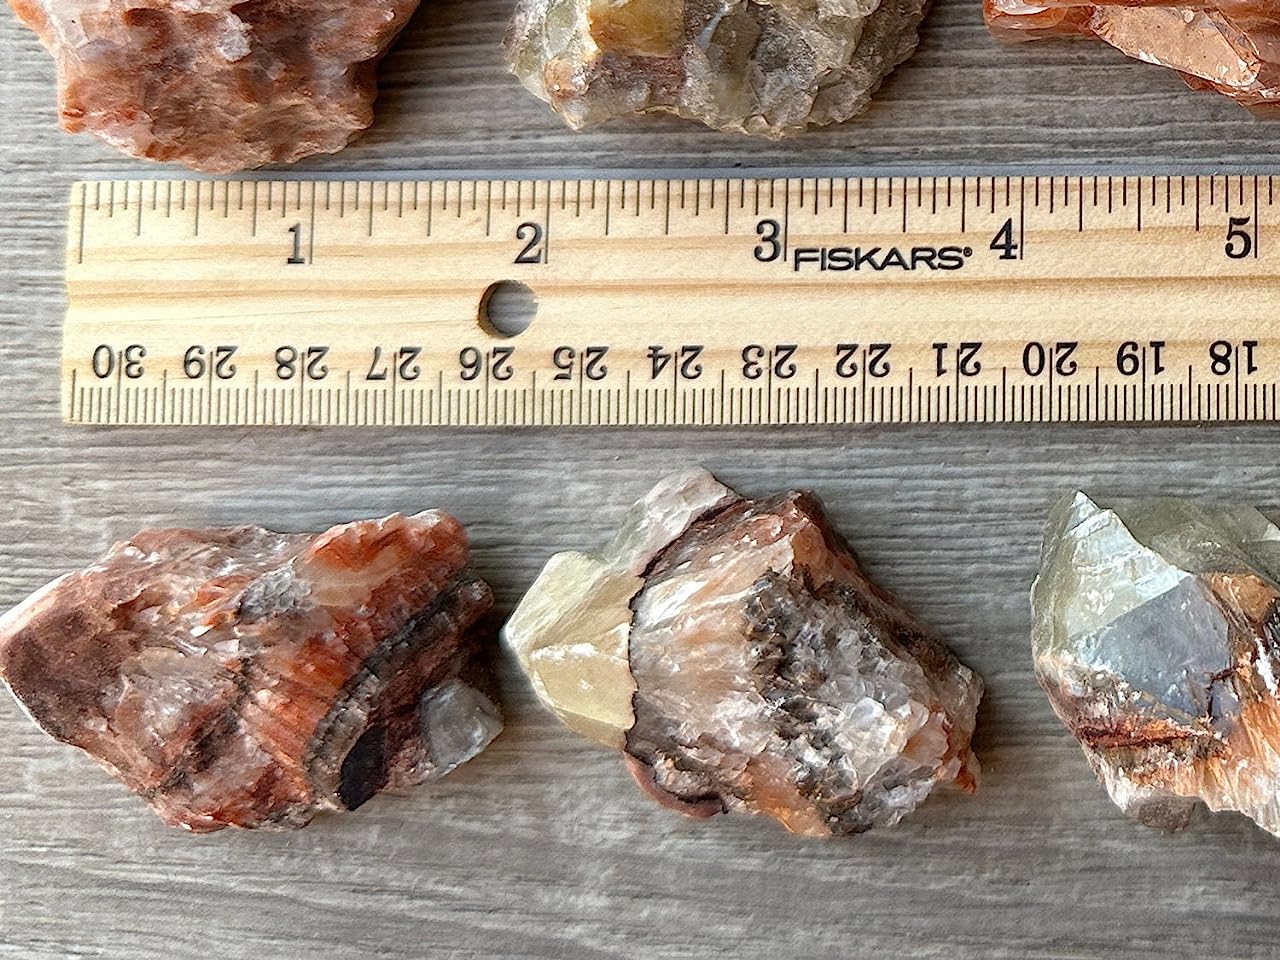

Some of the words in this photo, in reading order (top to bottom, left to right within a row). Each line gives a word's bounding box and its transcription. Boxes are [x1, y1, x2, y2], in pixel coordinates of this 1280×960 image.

[286, 223, 306, 265] 1
[514, 222, 543, 265] 2
[753, 219, 782, 263] 3
[989, 217, 1019, 261] 4
[1224, 215, 1252, 259] 5
[93, 344, 147, 380] 30
[183, 344, 238, 380] 29
[274, 345, 331, 381] 28
[365, 345, 423, 381] 27
[459, 345, 515, 381] 26
[553, 346, 610, 381] 25
[647, 345, 705, 380] 24
[741, 344, 799, 380] 23
[835, 343, 893, 379] 22
[932, 342, 983, 378] 21
[1022, 341, 1079, 377] 20
[1116, 340, 1167, 376] 19
[1208, 340, 1259, 376] 18
